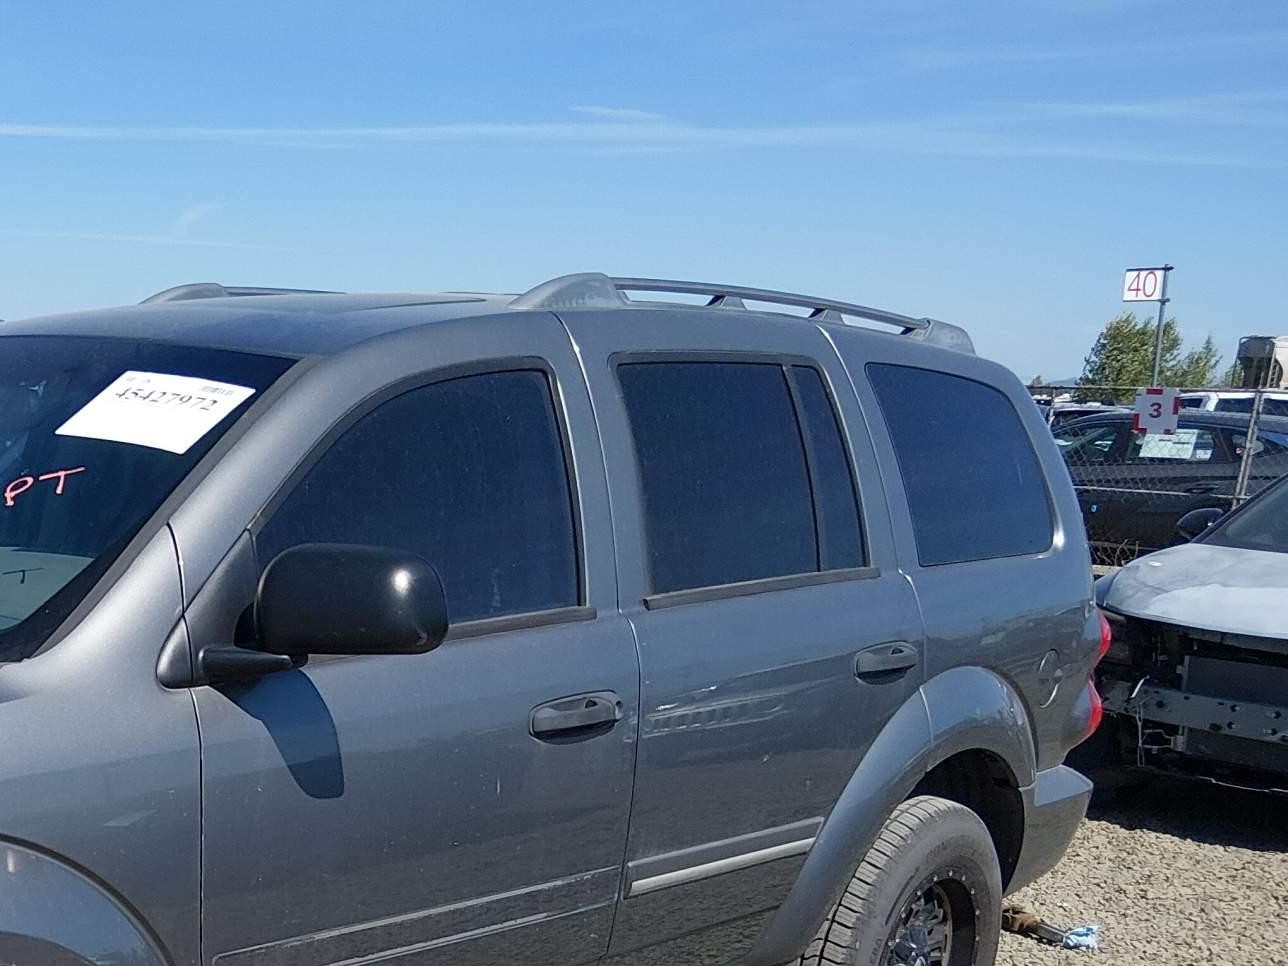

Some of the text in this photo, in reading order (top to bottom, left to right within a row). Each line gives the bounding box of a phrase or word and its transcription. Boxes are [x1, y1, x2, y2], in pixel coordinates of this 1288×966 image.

[1127, 271, 1158, 298] 40
[114, 387, 218, 411] 45427972
[1148, 402, 1162, 419] 3
[4, 467, 86, 506] PT
